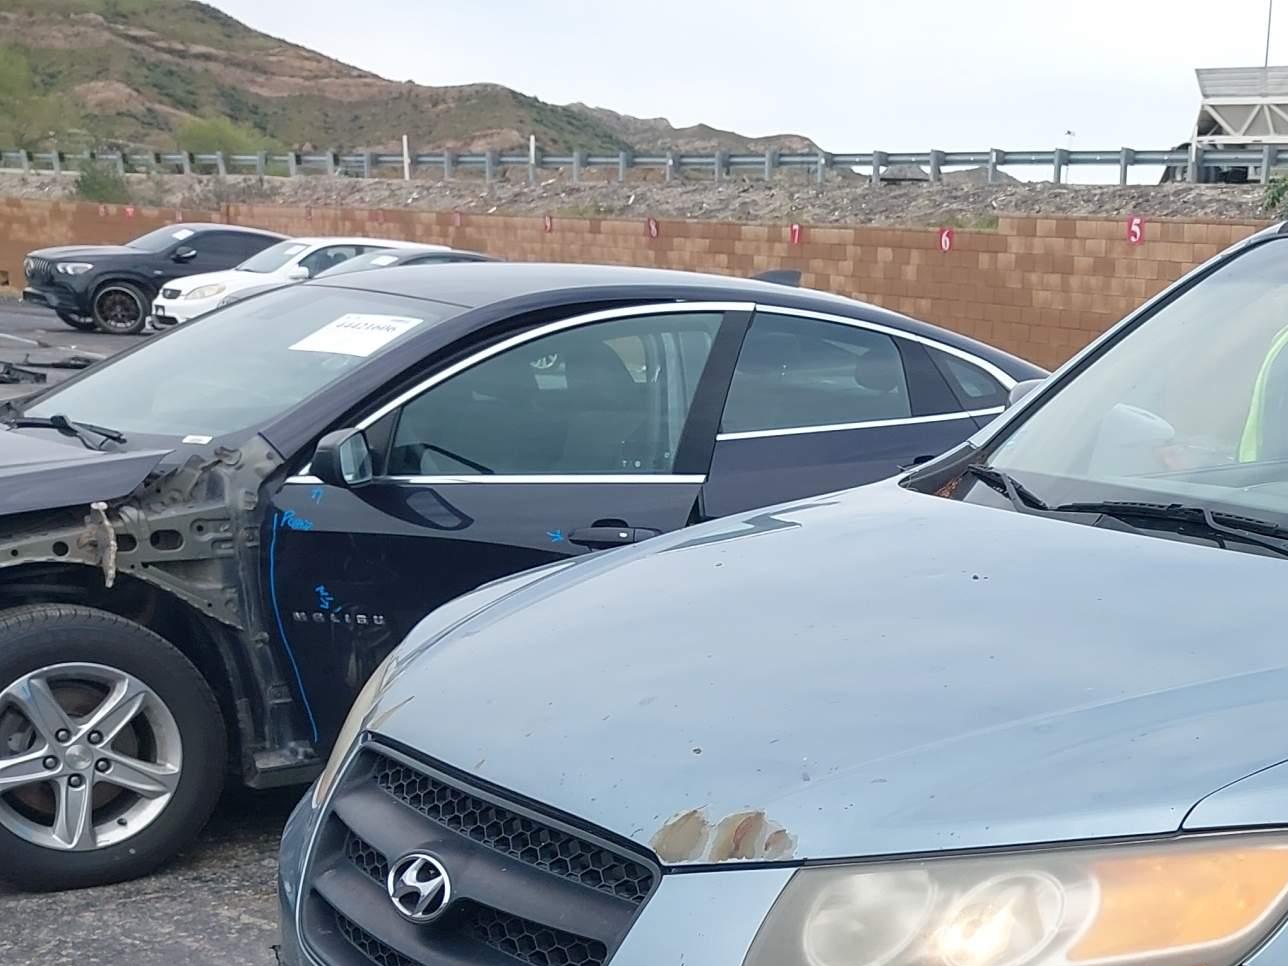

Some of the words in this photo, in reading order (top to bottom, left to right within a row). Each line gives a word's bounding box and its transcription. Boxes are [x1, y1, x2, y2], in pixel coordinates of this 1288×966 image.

[792, 224, 799, 244] 7
[941, 229, 950, 251] 6
[1130, 218, 1141, 242] 5
[292, 610, 386, 625] MALIBU
